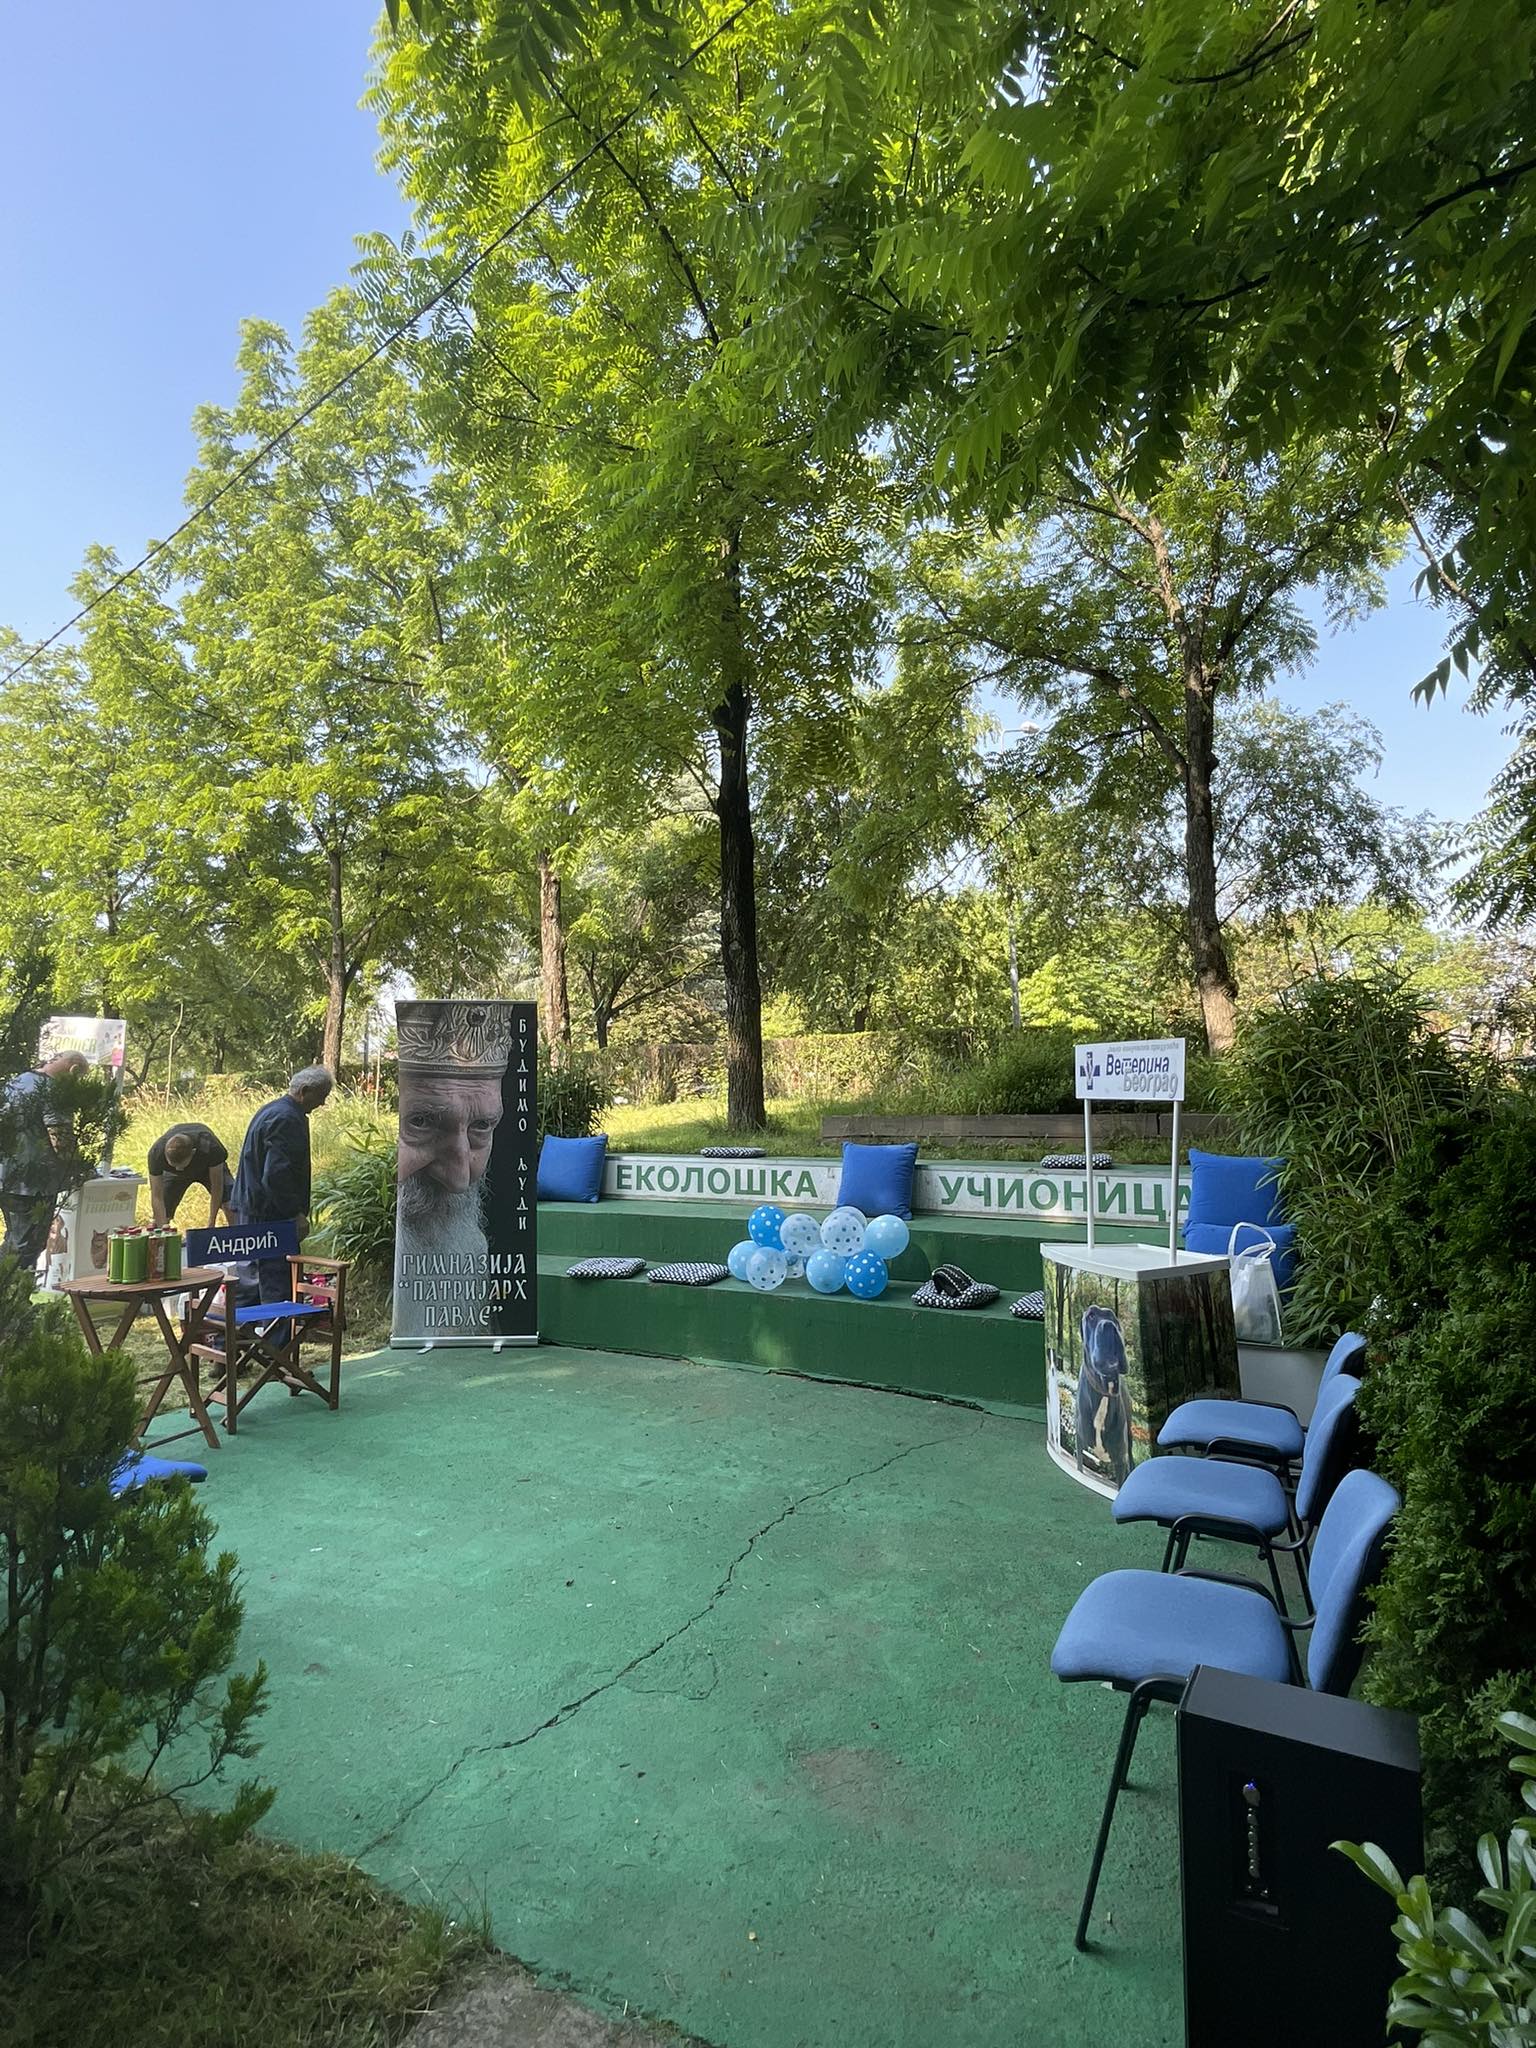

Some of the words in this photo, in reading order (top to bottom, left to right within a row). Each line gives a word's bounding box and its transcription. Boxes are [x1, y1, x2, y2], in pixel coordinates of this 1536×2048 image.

[516, 1018, 529, 1132] БУДИМО
[1123, 1072, 1179, 1098] Београд
[516, 1157, 529, 1231] ЉУДИ
[616, 1164, 819, 1198] ЕКОЛОШКА
[207, 1230, 278, 1255] Андрић
[402, 1253, 526, 1275] ГИМНАЗИЈА
